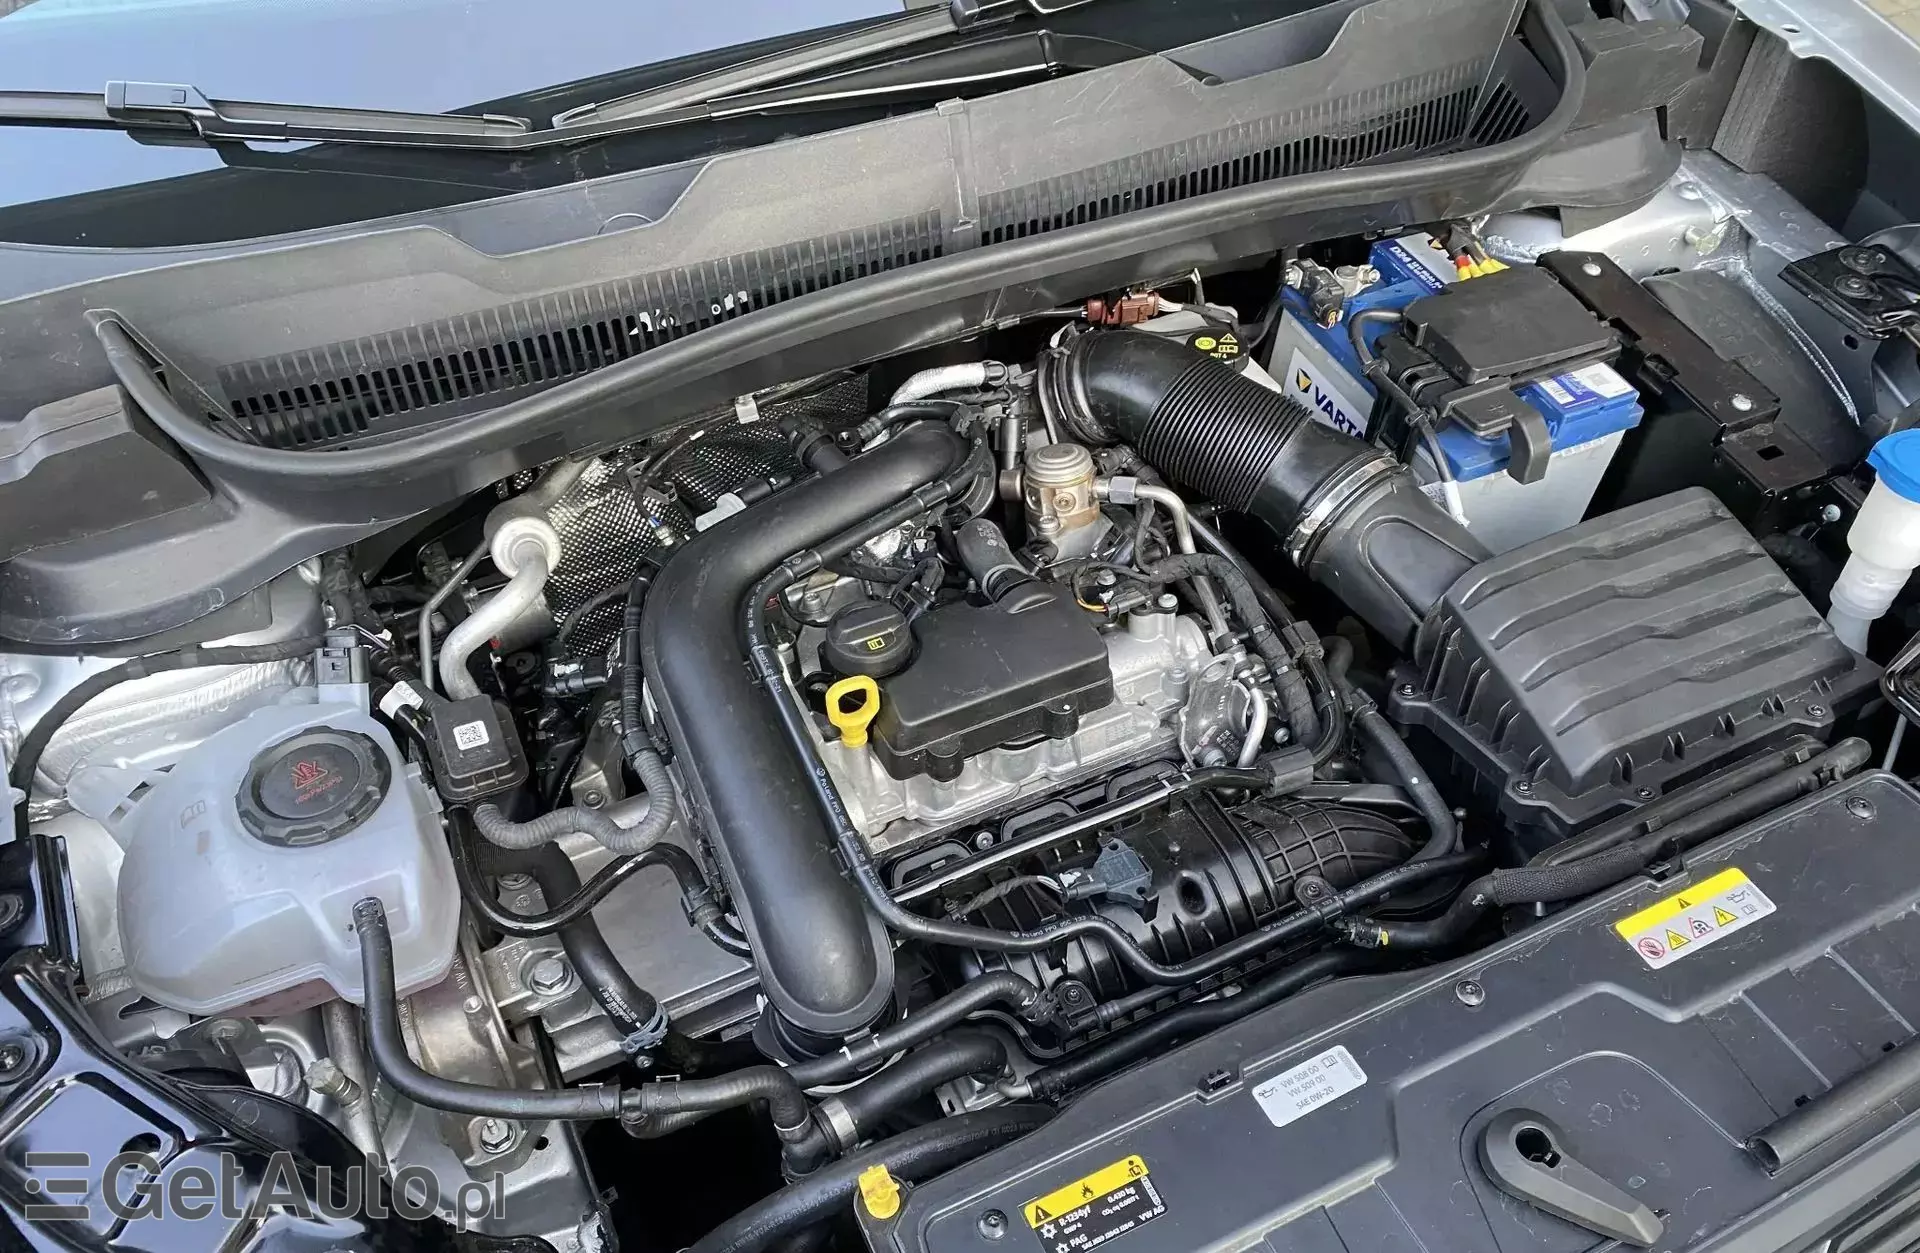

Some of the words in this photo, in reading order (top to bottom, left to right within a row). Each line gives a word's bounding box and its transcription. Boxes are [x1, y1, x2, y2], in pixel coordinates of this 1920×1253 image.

[1388, 246, 1412, 263] D24
[820, 778, 834, 800] Poland
[1272, 915, 1295, 928] Poland
[1021, 929, 1044, 938] Poland
[1044, 925, 1057, 934] PPO
[1281, 1078, 1294, 1088] VW
[1294, 1070, 1309, 1080] 508
[1308, 1065, 1320, 1074] 00
[1288, 1087, 1300, 1098] VW
[1300, 1079, 1316, 1091] 509
[1315, 1074, 1326, 1083] 00
[1296, 1099, 1310, 1110] SAE
[1310, 1086, 1334, 1103] 0W-20
[1107, 1190, 1126, 1204] 0.430
[1124, 1186, 1136, 1196] kg
[1058, 1205, 1091, 1227] R-1234yf
[1138, 1210, 1153, 1222] VW
[1154, 1205, 1166, 1216] AG
[1070, 1234, 1088, 1248] PAG
[1082, 1241, 1094, 1250] SAE
